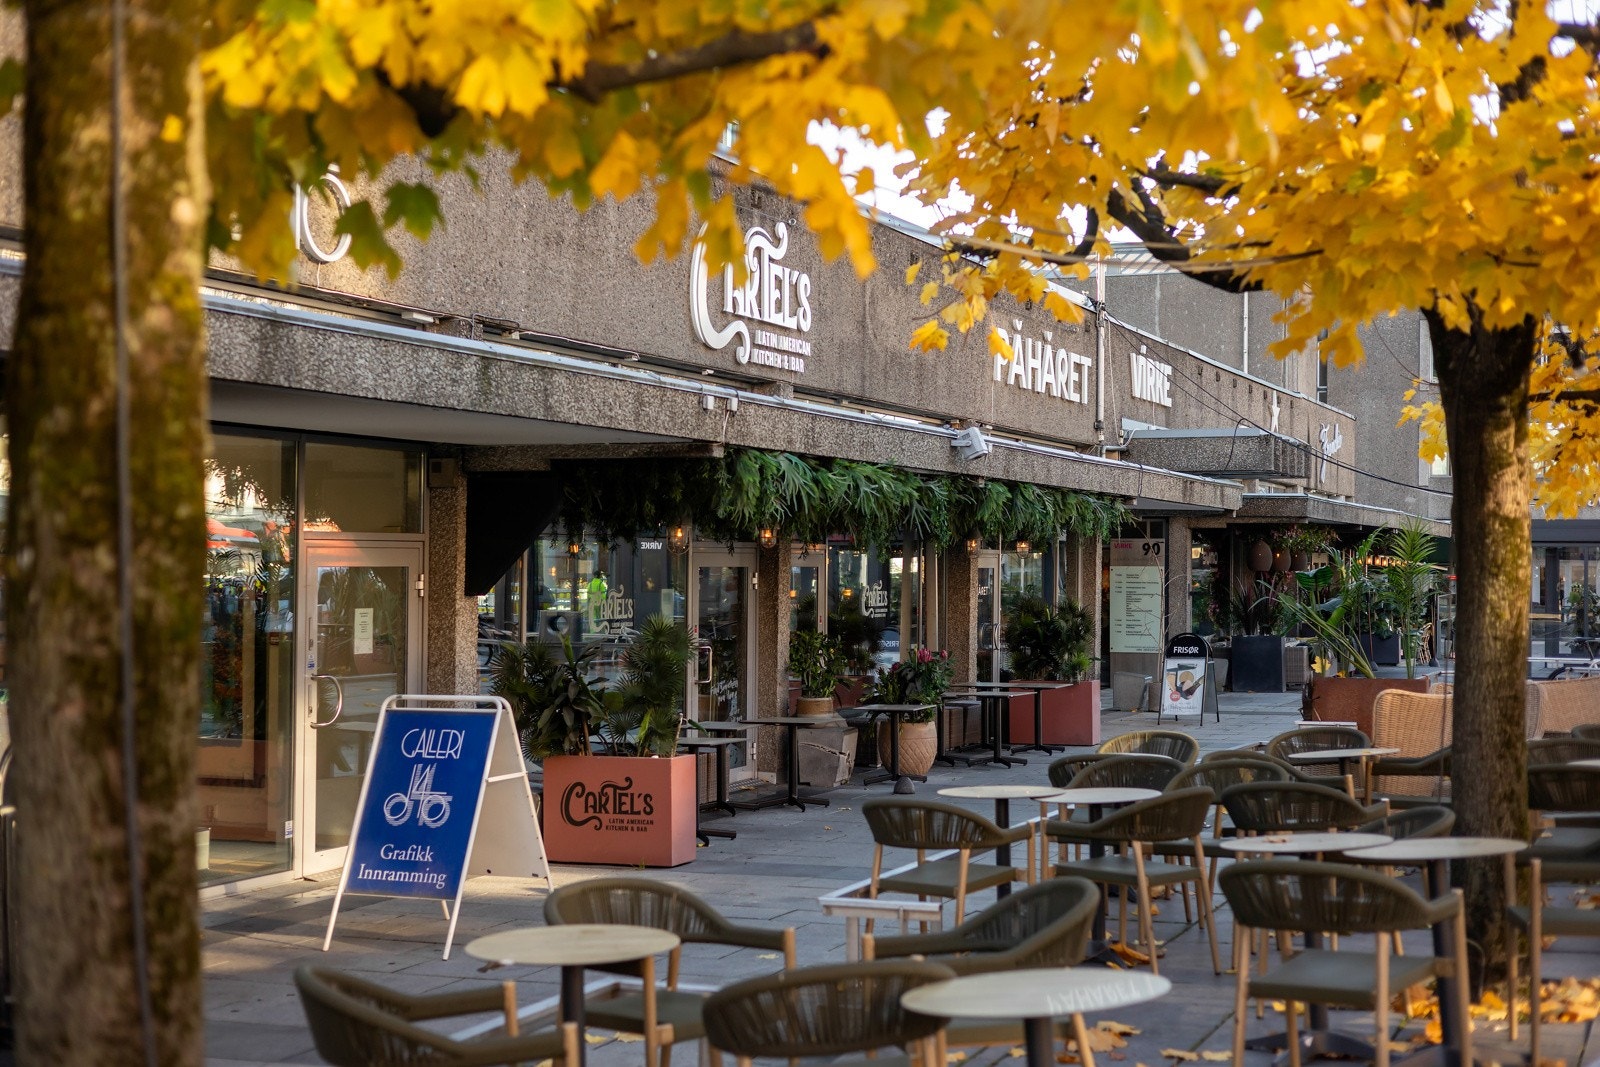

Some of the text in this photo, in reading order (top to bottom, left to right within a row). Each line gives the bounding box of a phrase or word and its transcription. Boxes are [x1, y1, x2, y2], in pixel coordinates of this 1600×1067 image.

[754, 329, 811, 356] LATIN AMERICAN
[750, 349, 805, 372] KITCHEN & BAR
[1142, 542, 1161, 555] 90
[1173, 646, 1199, 654] FRISØR
[401, 728, 465, 759] GALLERI
[561, 776, 654, 831] CARTEL'S
[380, 843, 433, 863] Grafikk
[357, 863, 447, 889] Innramming
